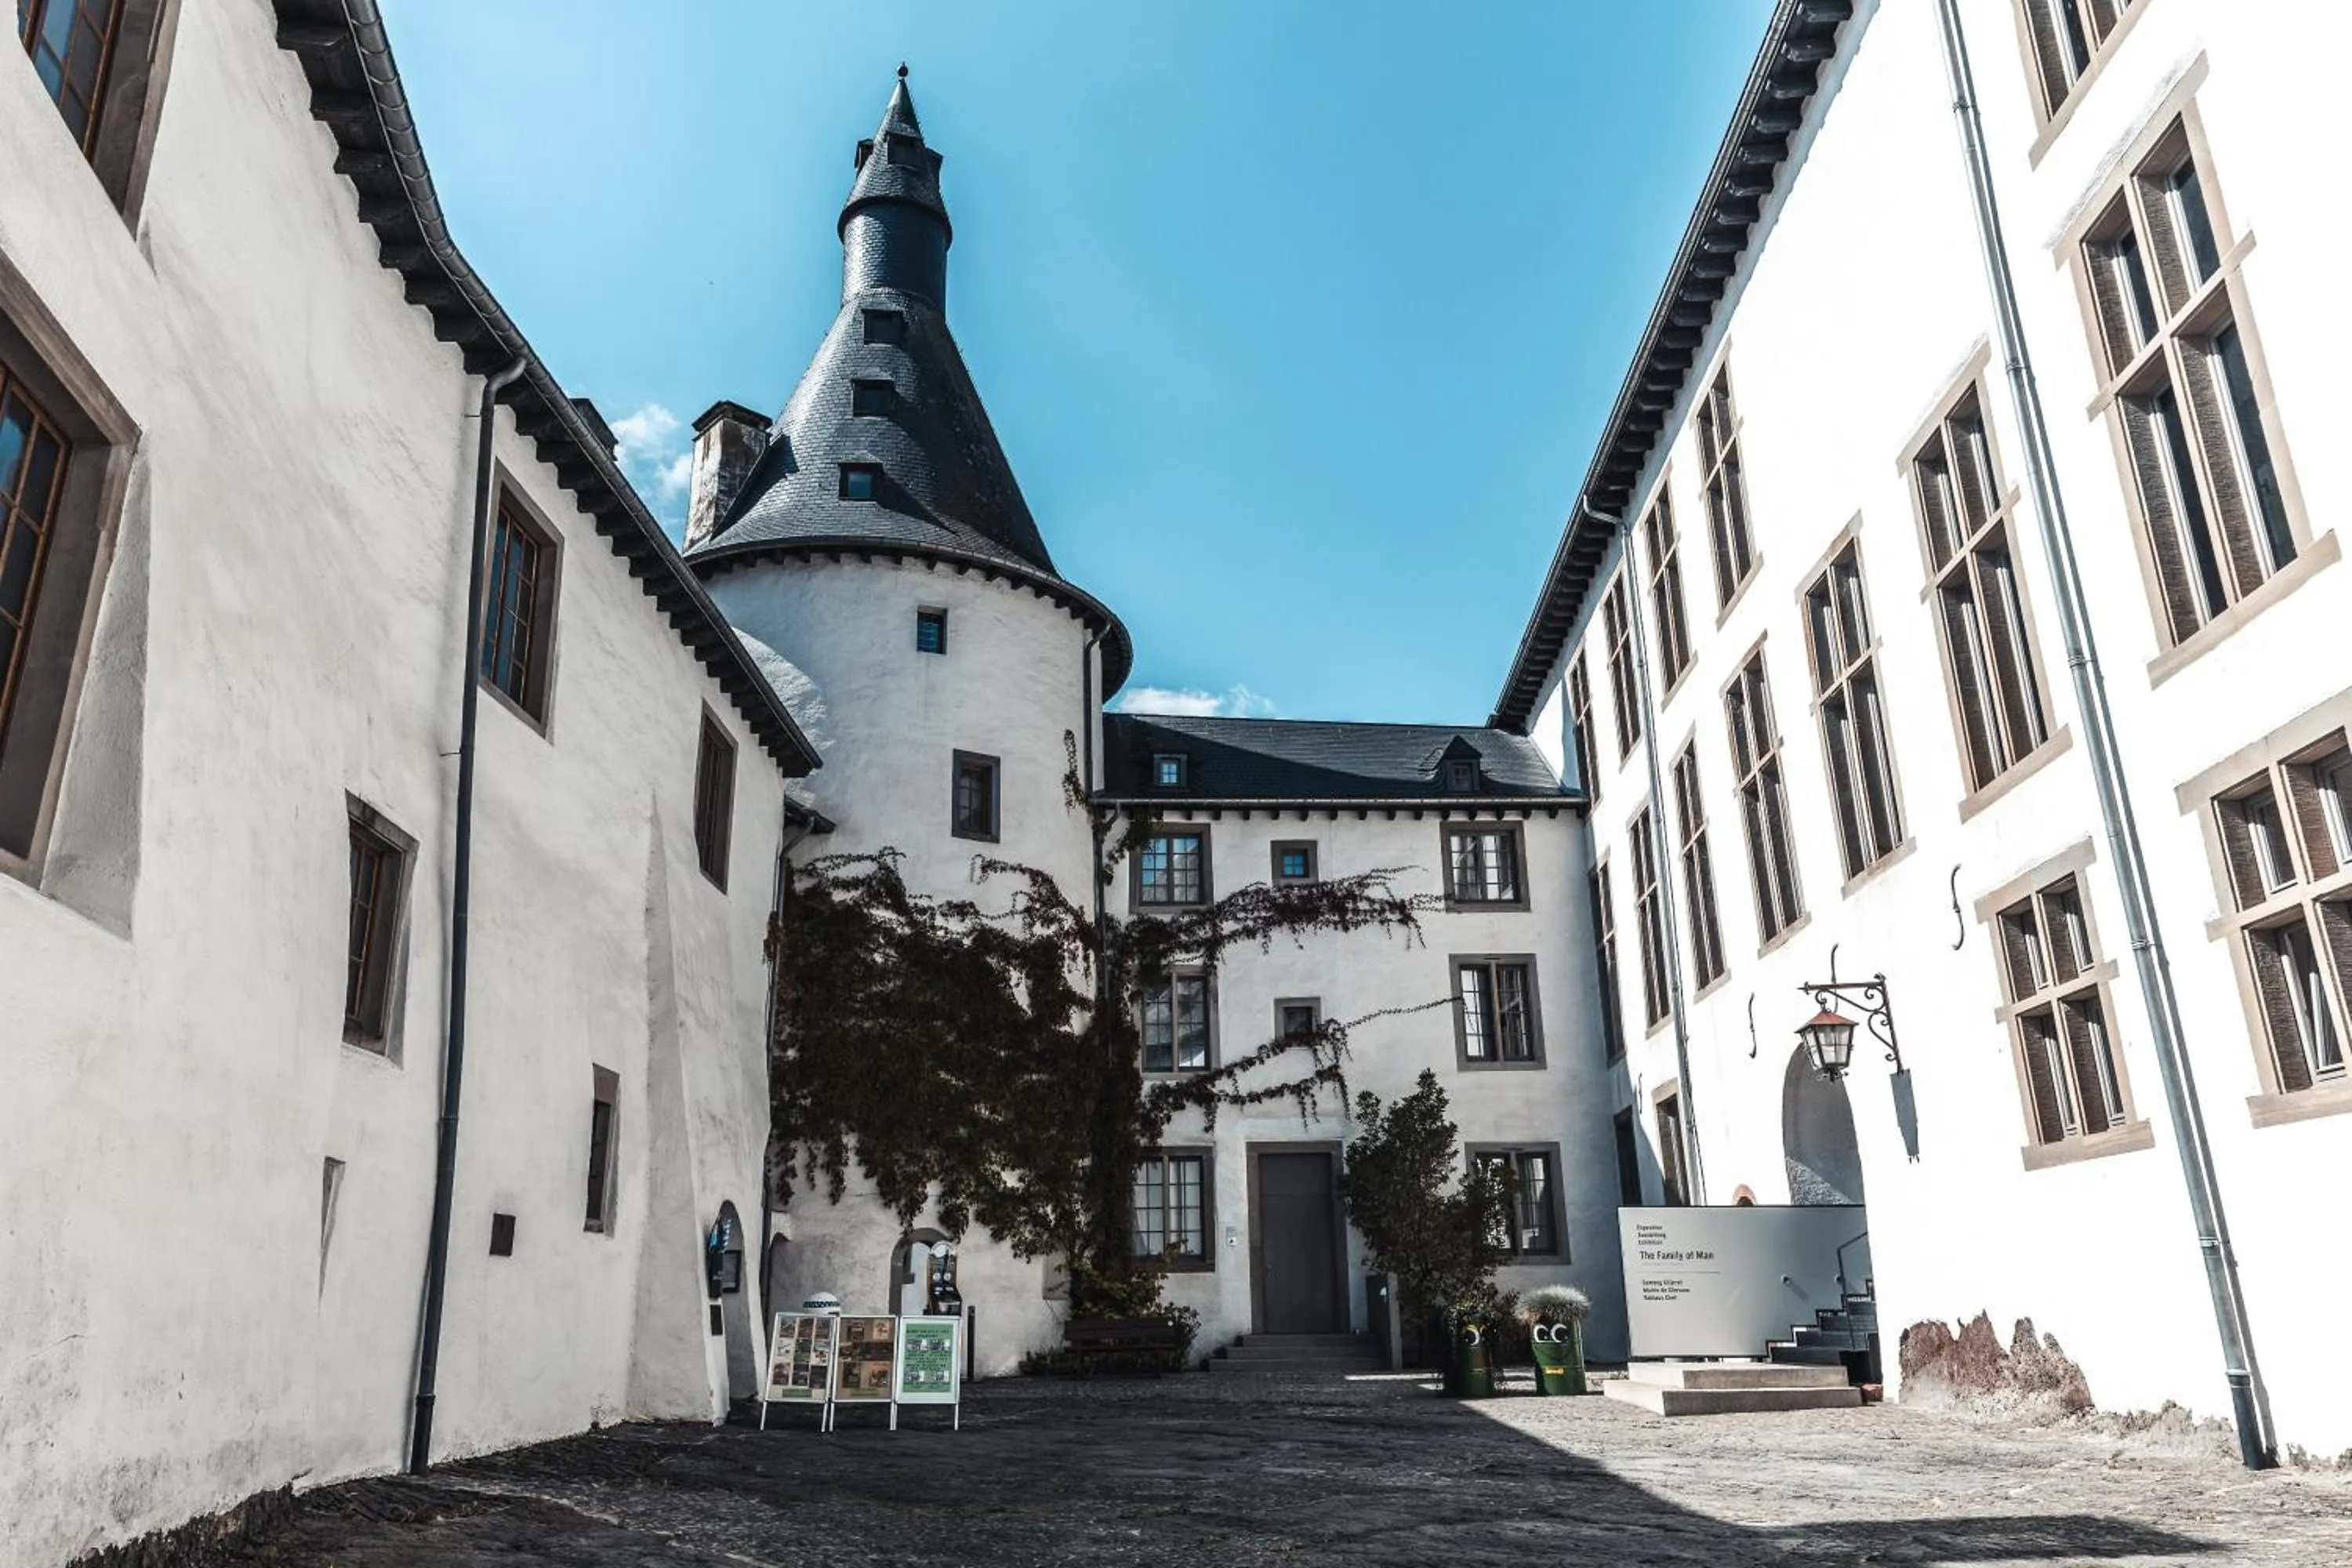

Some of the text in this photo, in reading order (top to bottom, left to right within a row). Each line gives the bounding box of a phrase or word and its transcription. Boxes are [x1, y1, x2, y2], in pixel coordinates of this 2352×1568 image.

[1640, 1250, 1715, 1261] The Family of Man
